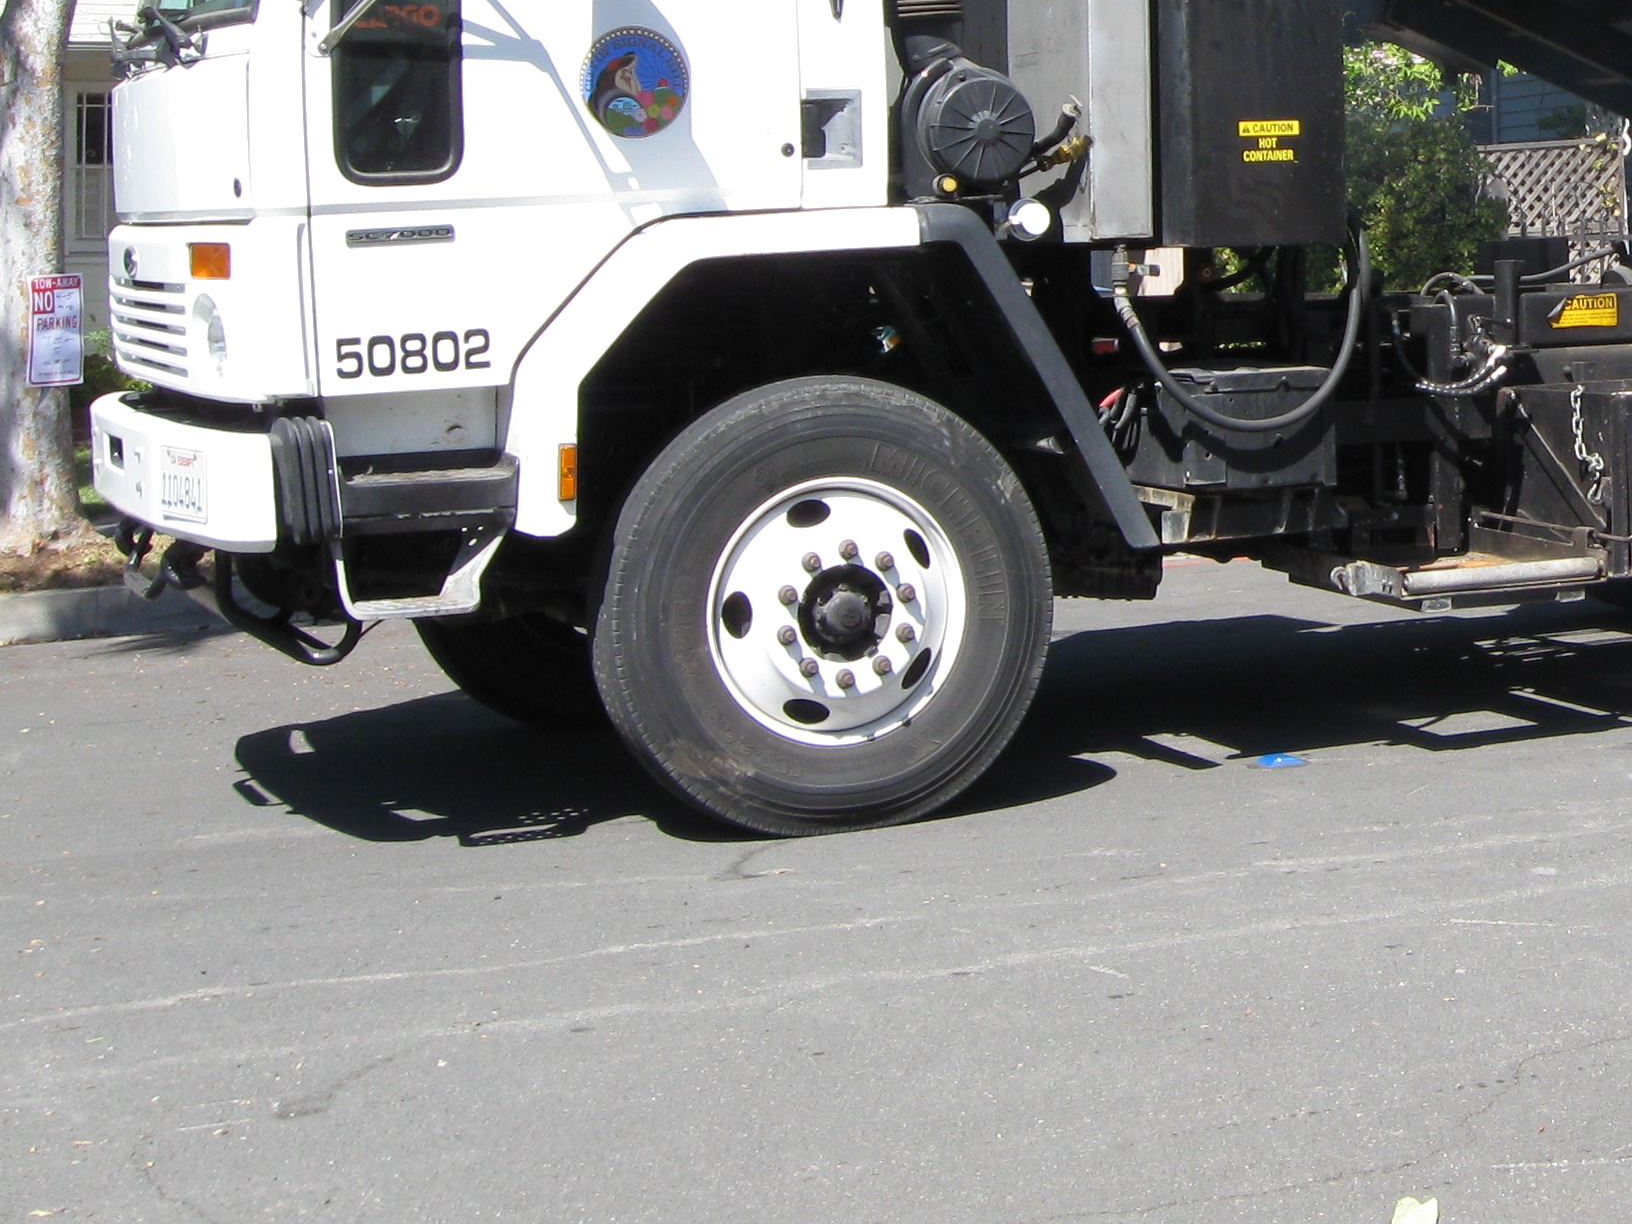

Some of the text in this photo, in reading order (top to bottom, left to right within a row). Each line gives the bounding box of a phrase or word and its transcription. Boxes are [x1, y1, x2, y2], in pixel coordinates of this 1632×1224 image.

[1252, 123, 1294, 133] CAUTION
[1258, 137, 1278, 149] HOT
[1243, 149, 1294, 162] CONTAINER
[34, 277, 79, 290] TOW-AWAY
[34, 290, 53, 312] NO
[1565, 297, 1614, 310] CAUTION
[37, 315, 78, 331] PARKING
[335, 327, 492, 380] 50802
